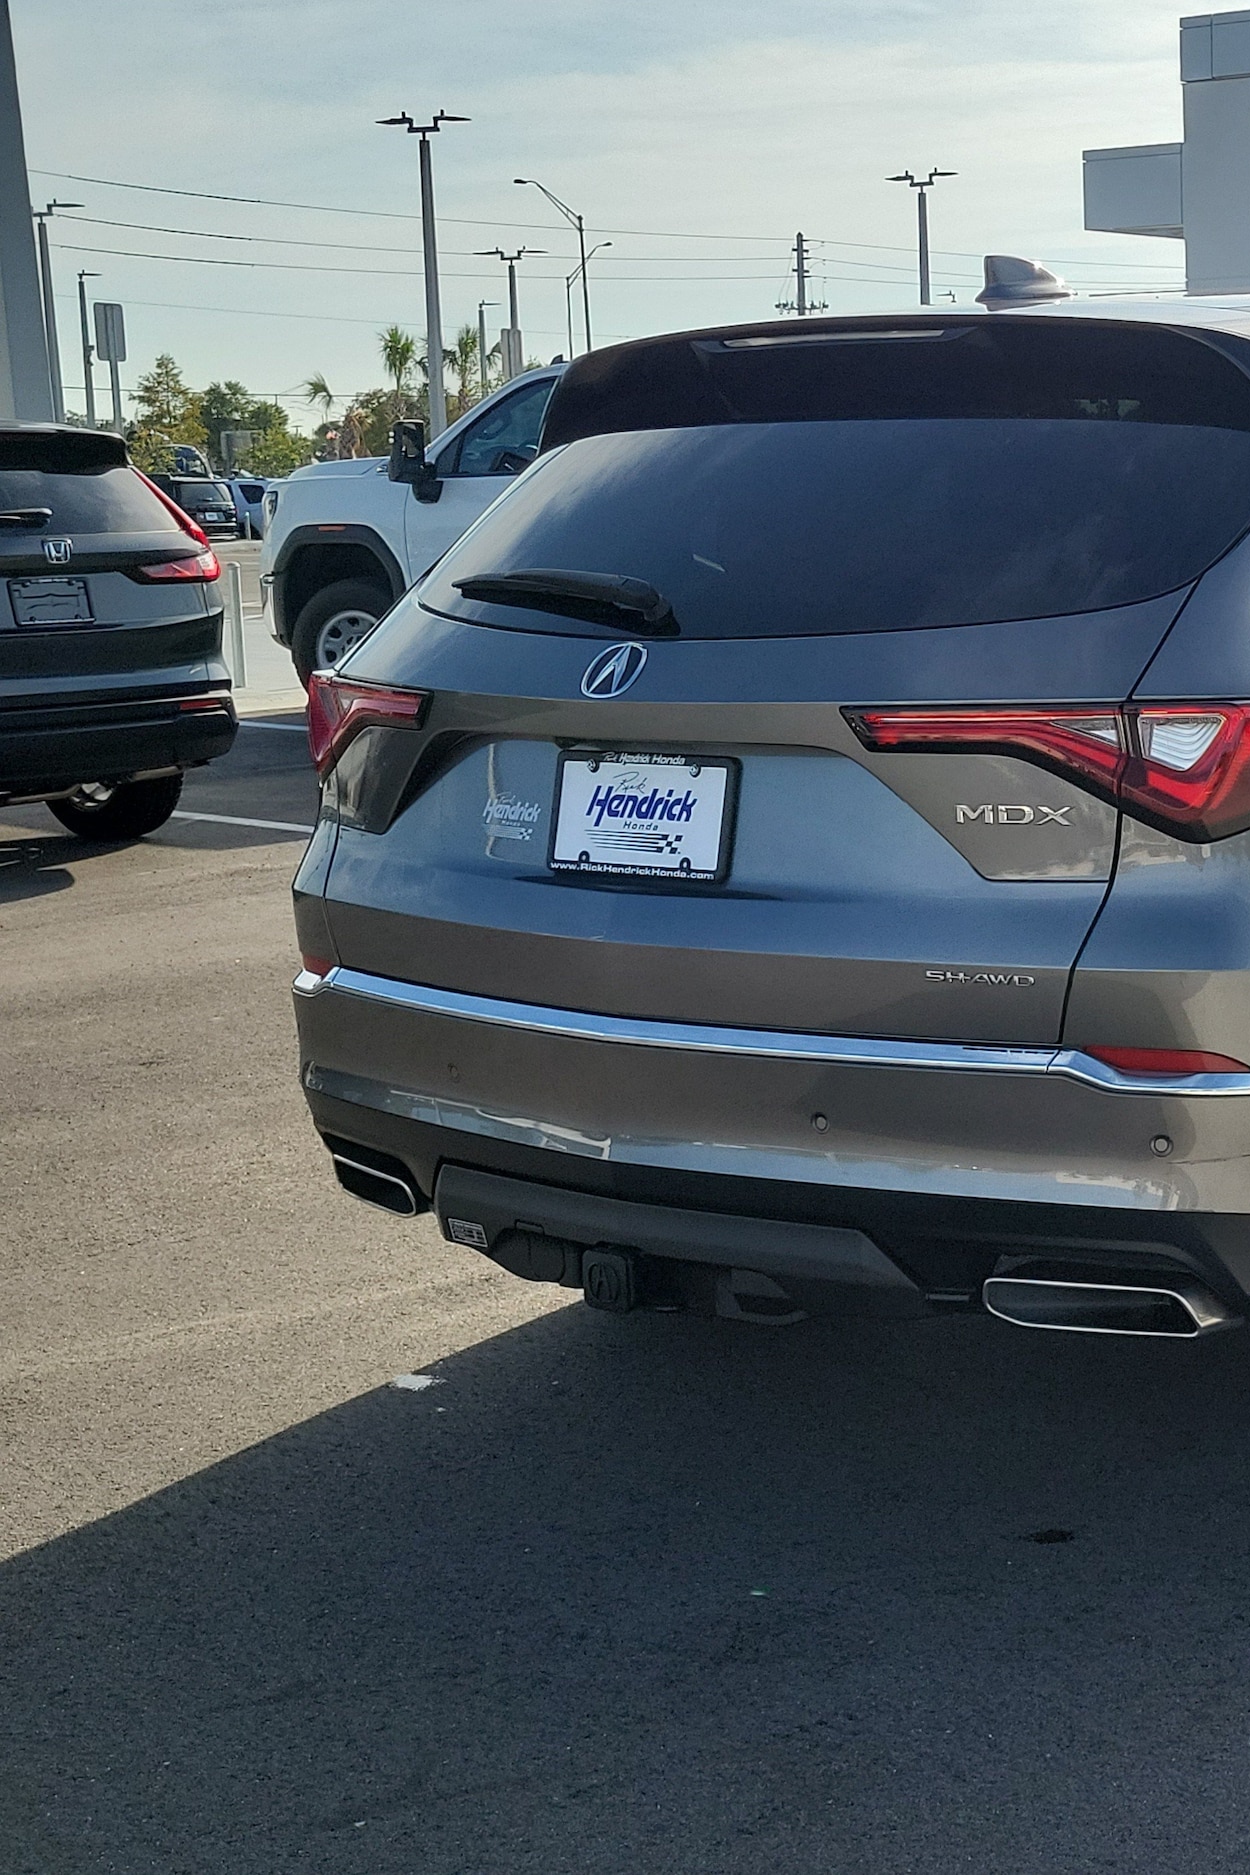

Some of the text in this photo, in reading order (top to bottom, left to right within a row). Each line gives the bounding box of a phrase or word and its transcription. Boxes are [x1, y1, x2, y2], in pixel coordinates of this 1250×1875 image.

[619, 752, 649, 765] Hendrick
[651, 754, 686, 765] Honda
[483, 798, 541, 823] Hendrick
[586, 785, 697, 827] Hendrick
[955, 804, 1073, 826] MDX
[623, 821, 659, 831] Honda
[551, 861, 714, 880] www.RickHendrickHonda.com
